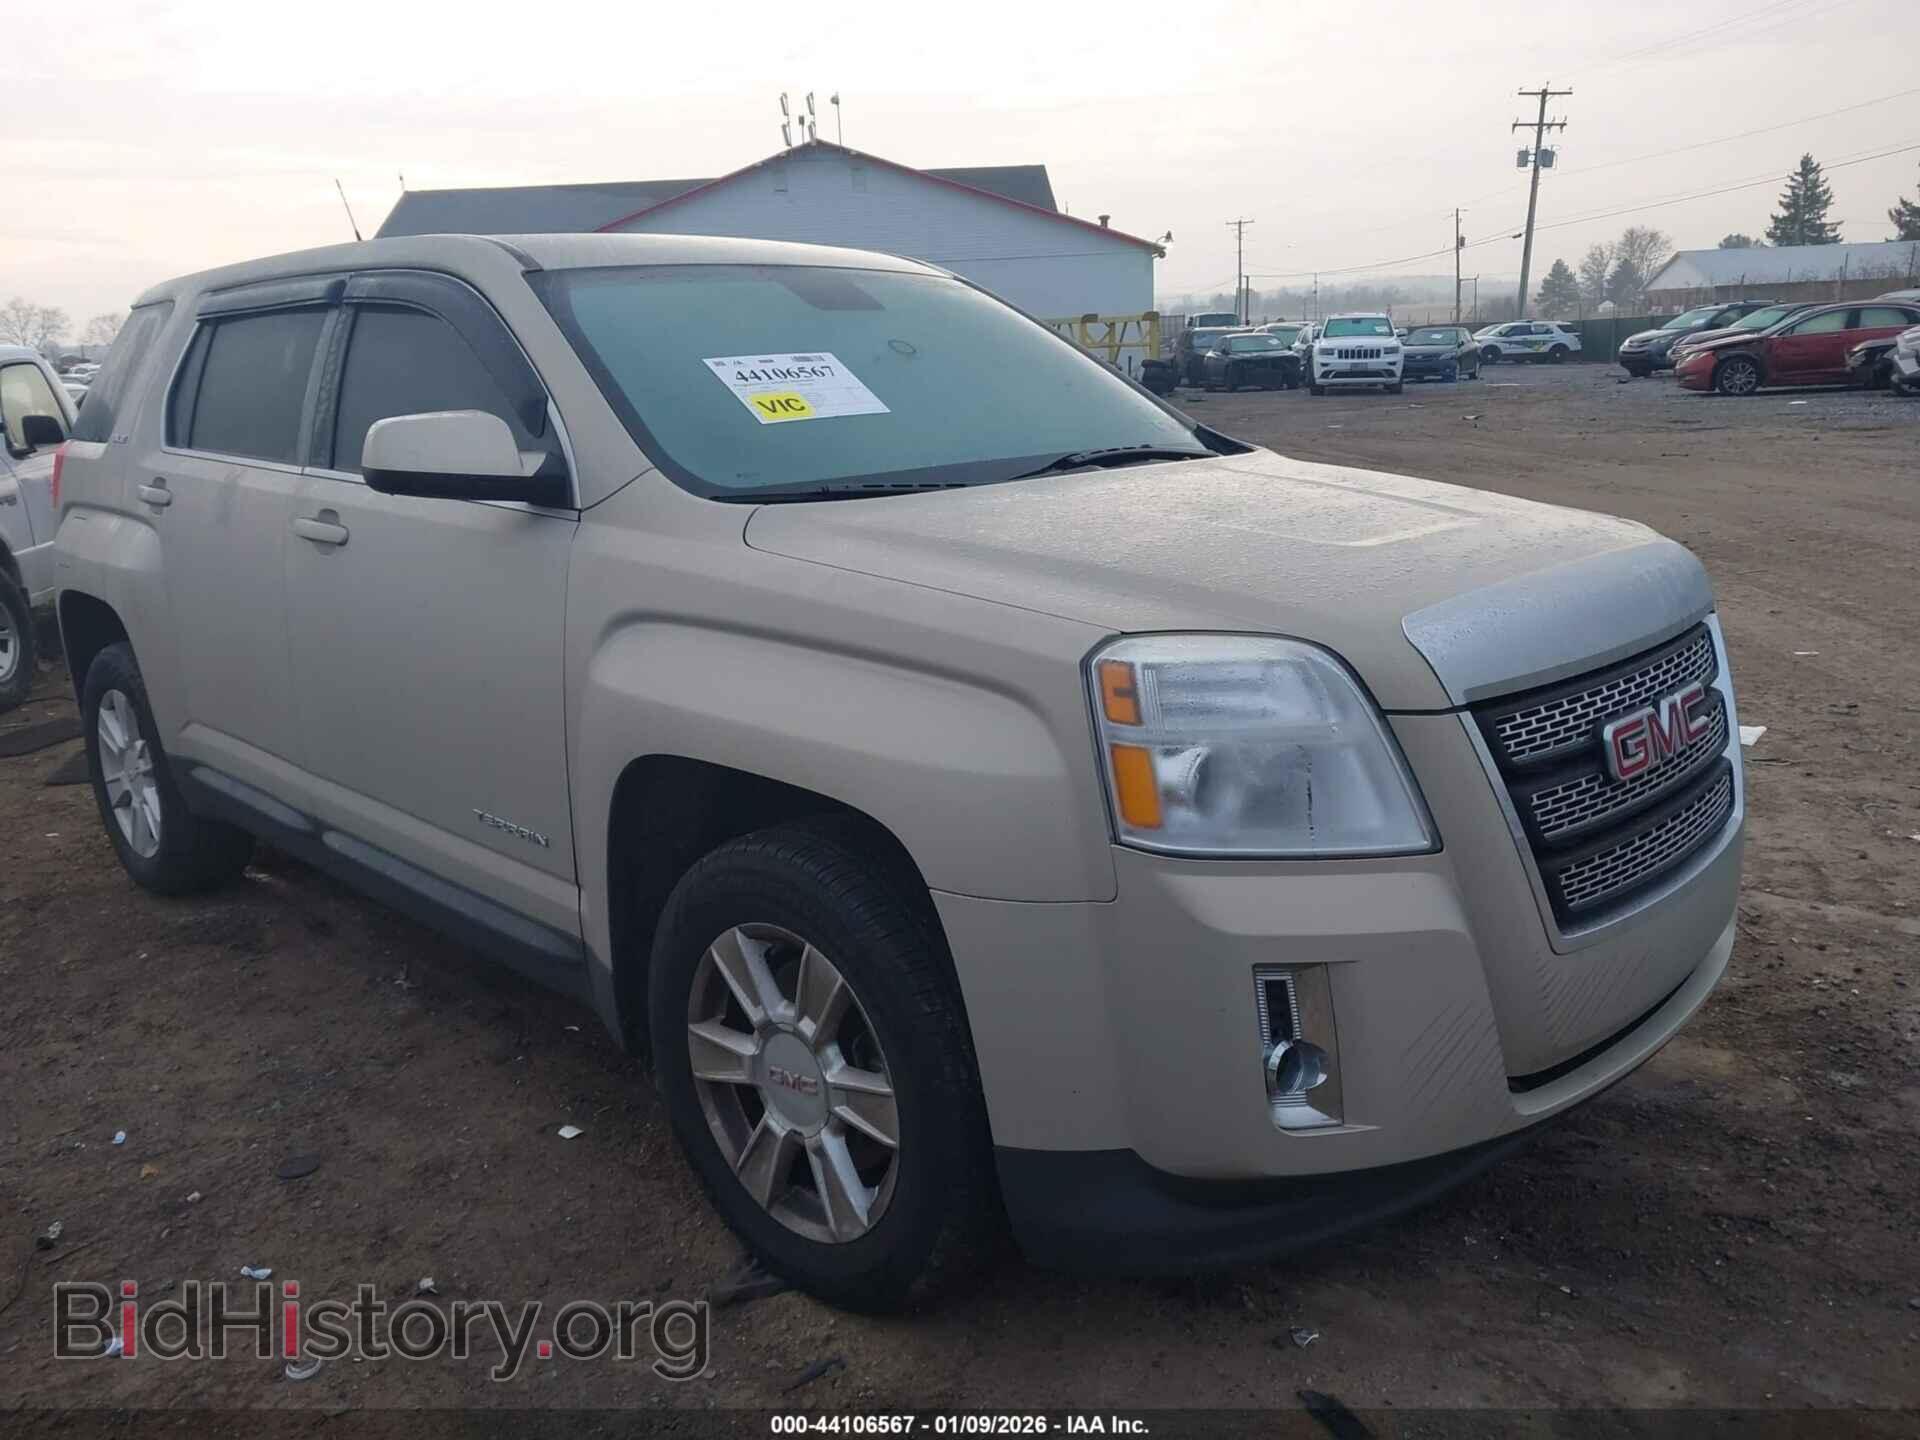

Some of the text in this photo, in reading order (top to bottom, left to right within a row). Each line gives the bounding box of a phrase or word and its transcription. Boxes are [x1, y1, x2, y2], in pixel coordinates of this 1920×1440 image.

[735, 365, 835, 382] 44106567
[757, 398, 805, 414] VIC
[1603, 681, 1713, 781] GMC
